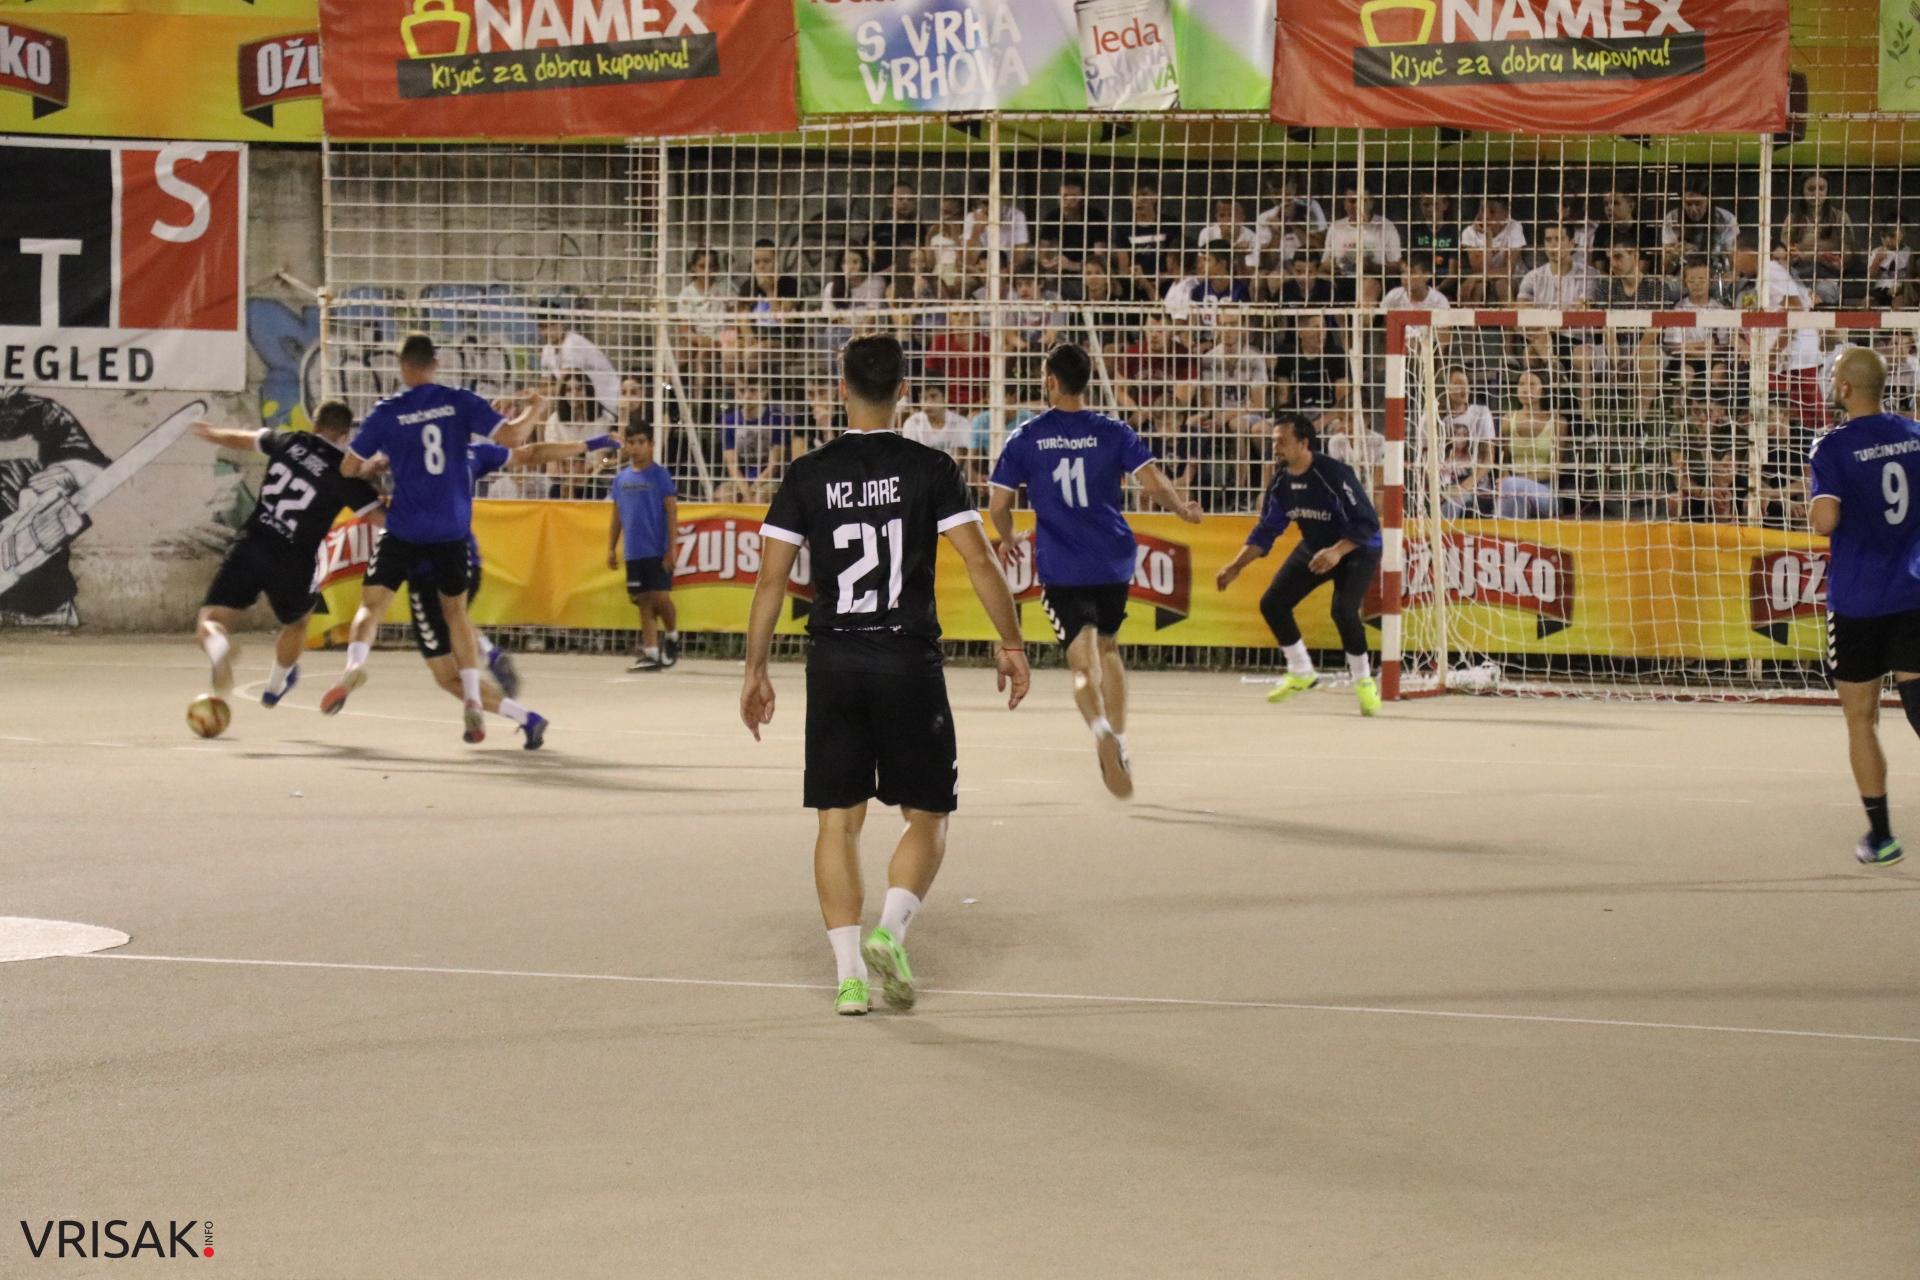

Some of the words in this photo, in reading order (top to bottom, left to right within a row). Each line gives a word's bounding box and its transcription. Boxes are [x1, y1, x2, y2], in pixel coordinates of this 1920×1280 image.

[474, 0, 709, 53] NAMEX
[856, 20, 886, 62] S
[902, 3, 1022, 57] VRHA
[1092, 17, 1162, 55] leda
[1441, 0, 1695, 43] NAMEX
[431, 59, 485, 95] Ključ
[492, 64, 528, 84] za
[535, 52, 591, 82] dobru
[598, 38, 690, 80] kupovinu!
[858, 47, 1029, 105] VRHOVA
[1390, 49, 1447, 86] Ključ
[1456, 55, 1492, 76] za
[1501, 44, 1563, 76] dobru
[1572, 38, 1671, 76] kupovinu!
[150, 150, 211, 243] S
[19, 237, 83, 327] T
[4, 344, 155, 383] EGLED
[421, 423, 446, 476] 8
[261, 462, 317, 532] 22
[857, 475, 901, 508] JARE
[1052, 456, 1089, 508] 11
[1881, 461, 1909, 525] 9
[832, 518, 903, 614] 21
